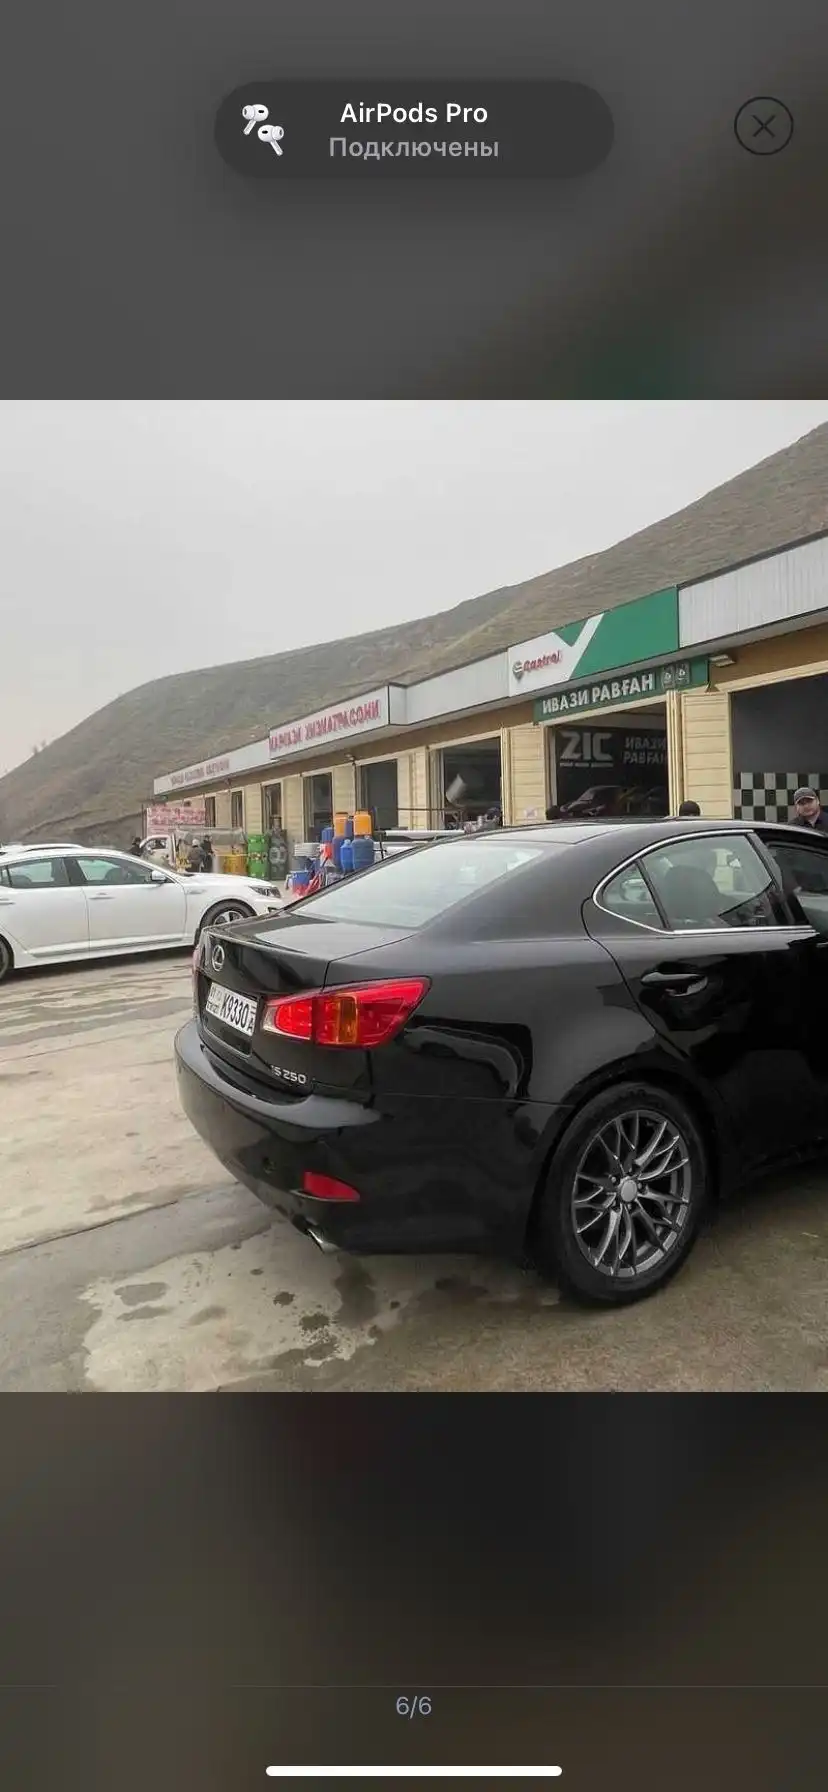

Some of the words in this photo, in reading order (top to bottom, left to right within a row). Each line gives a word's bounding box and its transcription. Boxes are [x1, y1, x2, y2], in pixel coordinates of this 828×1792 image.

[542, 689, 590, 715] ИВАЗИ
[560, 731, 613, 760] ZIC
[220, 993, 249, 1028] K9330
[282, 1069, 307, 1084] 250
